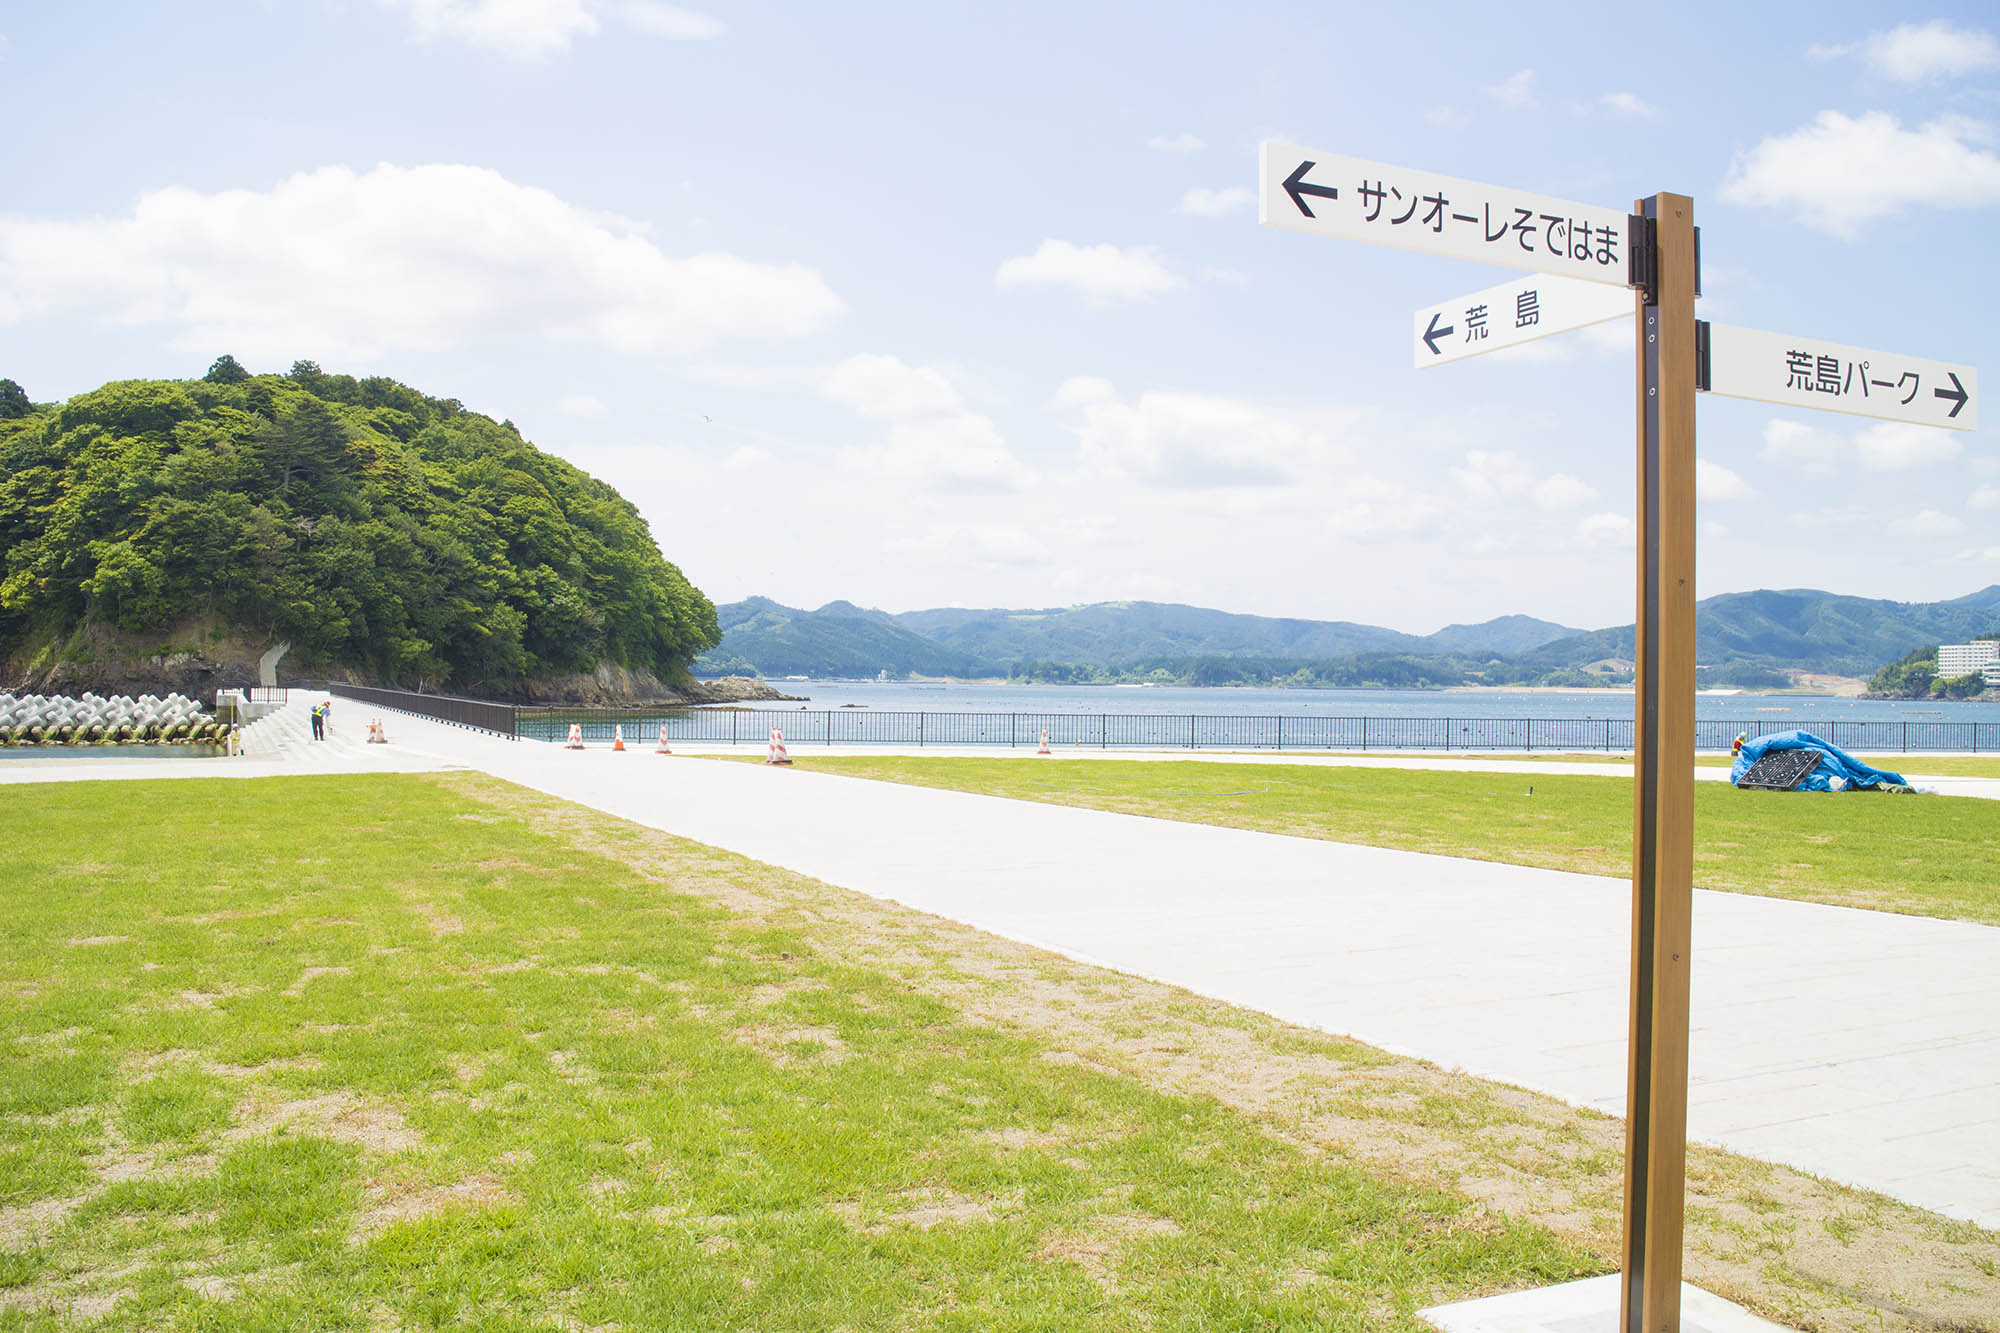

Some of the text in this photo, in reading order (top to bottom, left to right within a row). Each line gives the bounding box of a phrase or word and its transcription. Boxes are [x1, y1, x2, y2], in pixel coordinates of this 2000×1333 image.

[1357, 179, 1619, 265] サンオーレそではま
[1786, 349, 1920, 405] 荒島パーク
